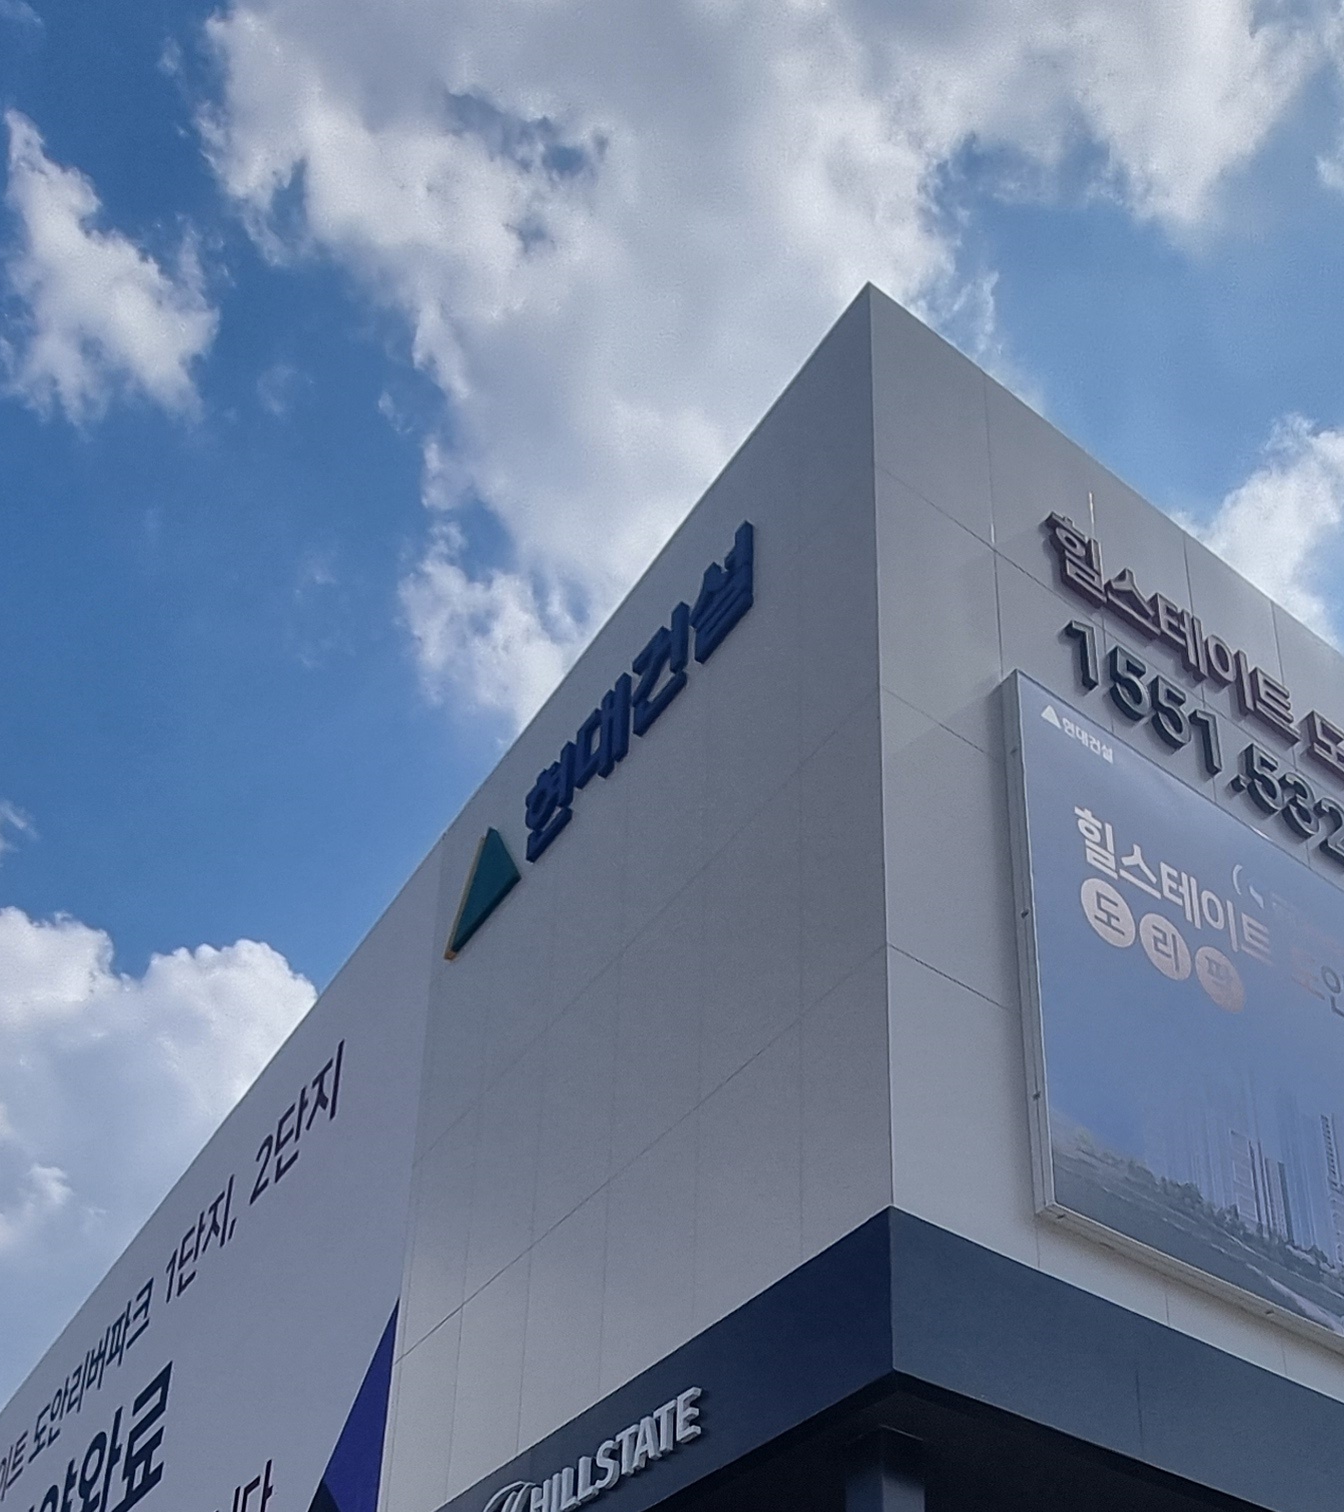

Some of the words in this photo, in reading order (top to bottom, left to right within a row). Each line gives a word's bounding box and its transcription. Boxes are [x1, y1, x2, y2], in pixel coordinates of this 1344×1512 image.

[524, 520, 755, 863] 현대건설
[1045, 511, 1301, 746] 힐스테이트
[1061, 717, 1115, 764] 현대건설
[1074, 805, 1276, 967] 힐스테이트
[27, 1277, 155, 1464] 도안리버파크
[165, 1174, 238, 1304] 1단지,
[249, 1039, 345, 1206] 2단지
